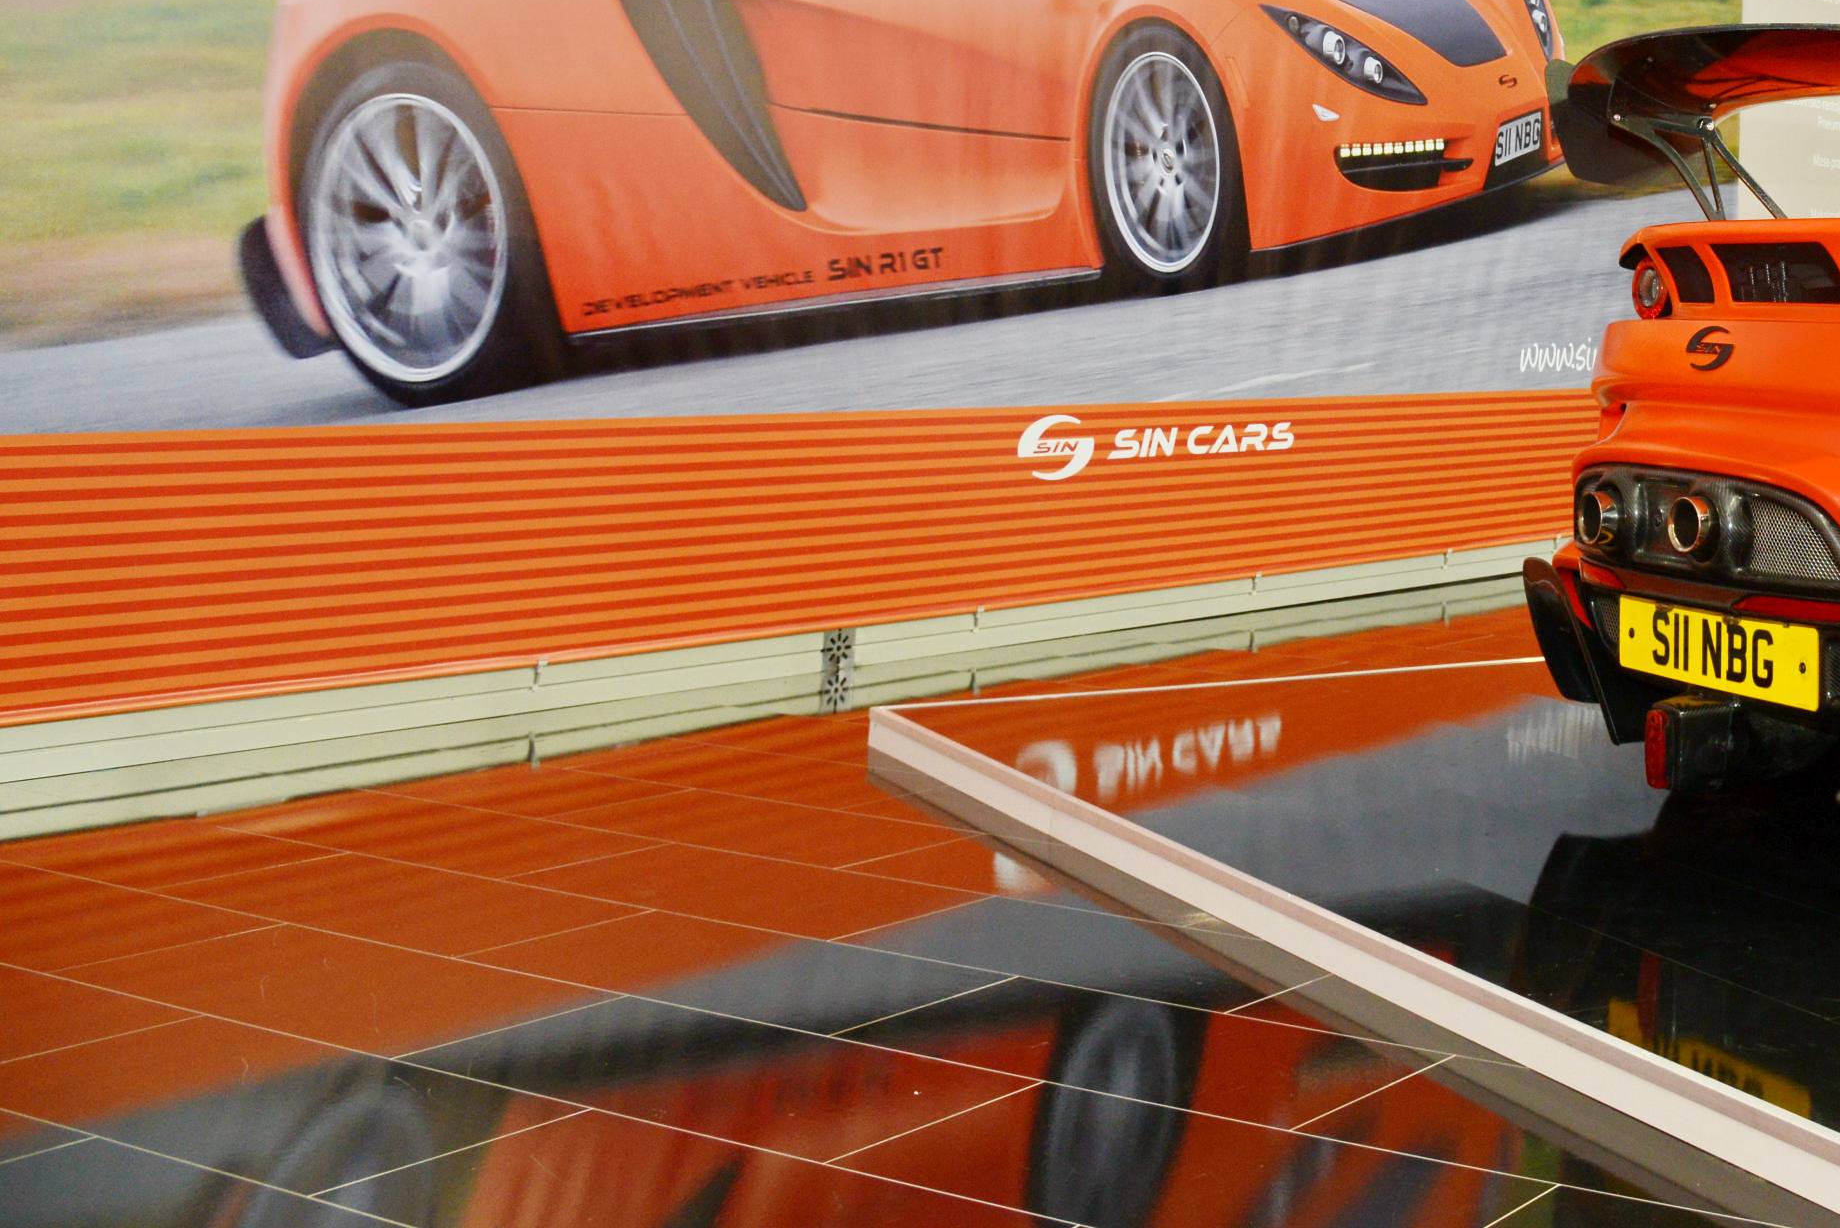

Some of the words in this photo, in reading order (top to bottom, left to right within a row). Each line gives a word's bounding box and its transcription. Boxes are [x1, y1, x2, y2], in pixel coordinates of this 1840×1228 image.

[1516, 118, 1541, 151] NBG
[583, 279, 733, 316] DEVELOPMENT
[743, 271, 815, 291] VEHICLE
[827, 254, 873, 282] SIN
[880, 252, 907, 275] R1
[913, 247, 944, 270] GT
[1032, 440, 1080, 454] SIN
[1107, 427, 1179, 459] SIN
[1186, 422, 1295, 454] CARS
[1701, 618, 1774, 689] NBG
